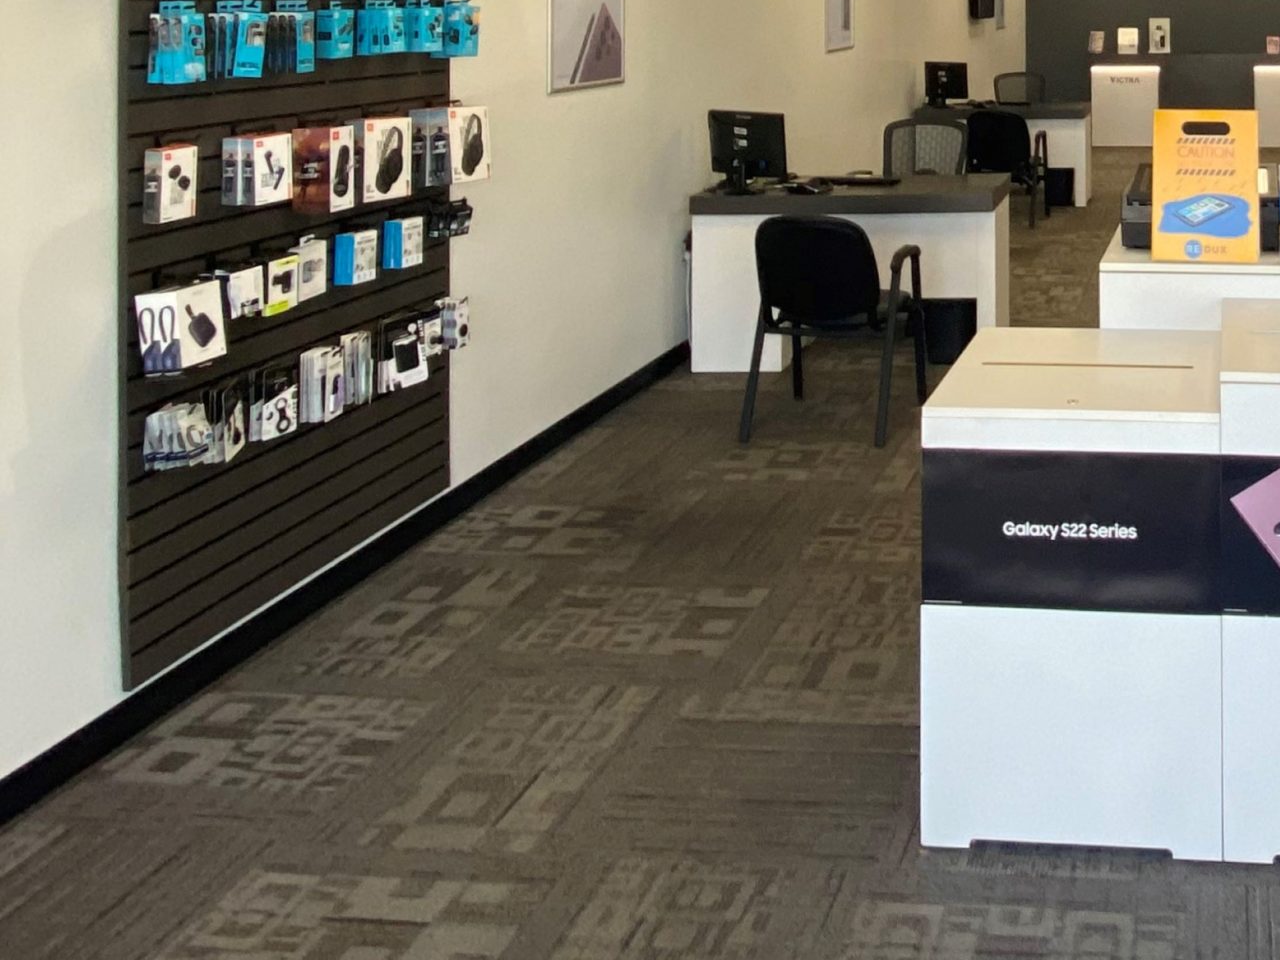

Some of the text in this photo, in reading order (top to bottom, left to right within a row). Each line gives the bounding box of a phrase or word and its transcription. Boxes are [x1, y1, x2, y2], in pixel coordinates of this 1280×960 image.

[1177, 145, 1235, 158] CAUTION
[1002, 521, 1138, 540] Galaxy S22 Series
